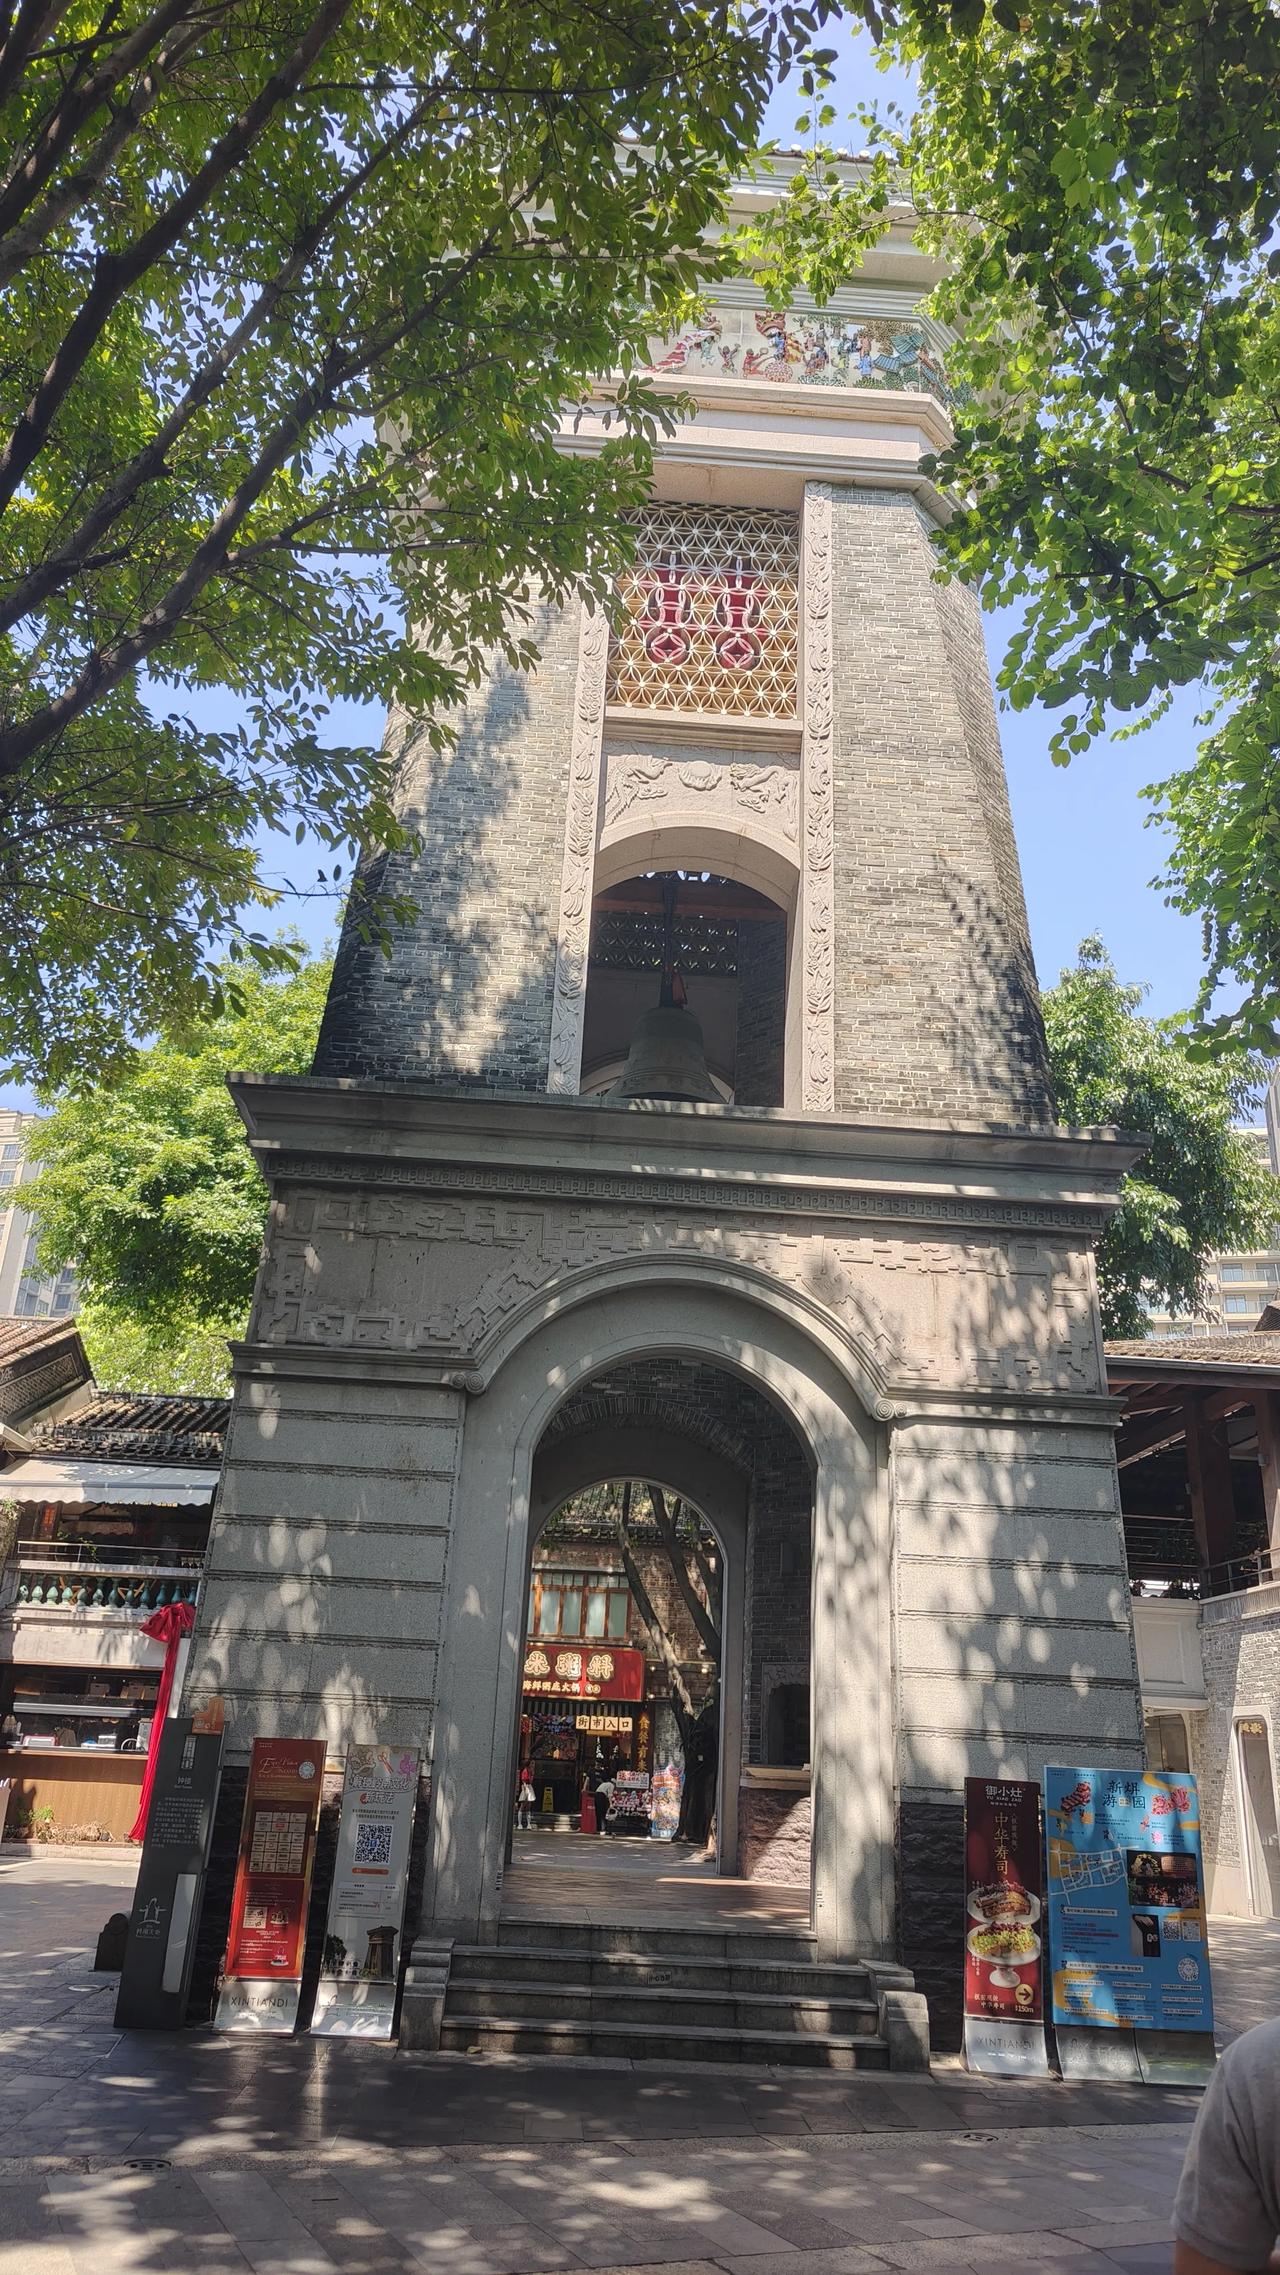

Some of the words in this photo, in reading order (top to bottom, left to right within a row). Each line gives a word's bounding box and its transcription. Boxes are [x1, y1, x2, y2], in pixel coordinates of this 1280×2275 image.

[577, 1717, 630, 1729] 街市入口
[985, 1785, 1023, 1798] 御小灶
[994, 1811, 1010, 1875] 中华寿司
[231, 1996, 289, 2009] XINTIANDI
